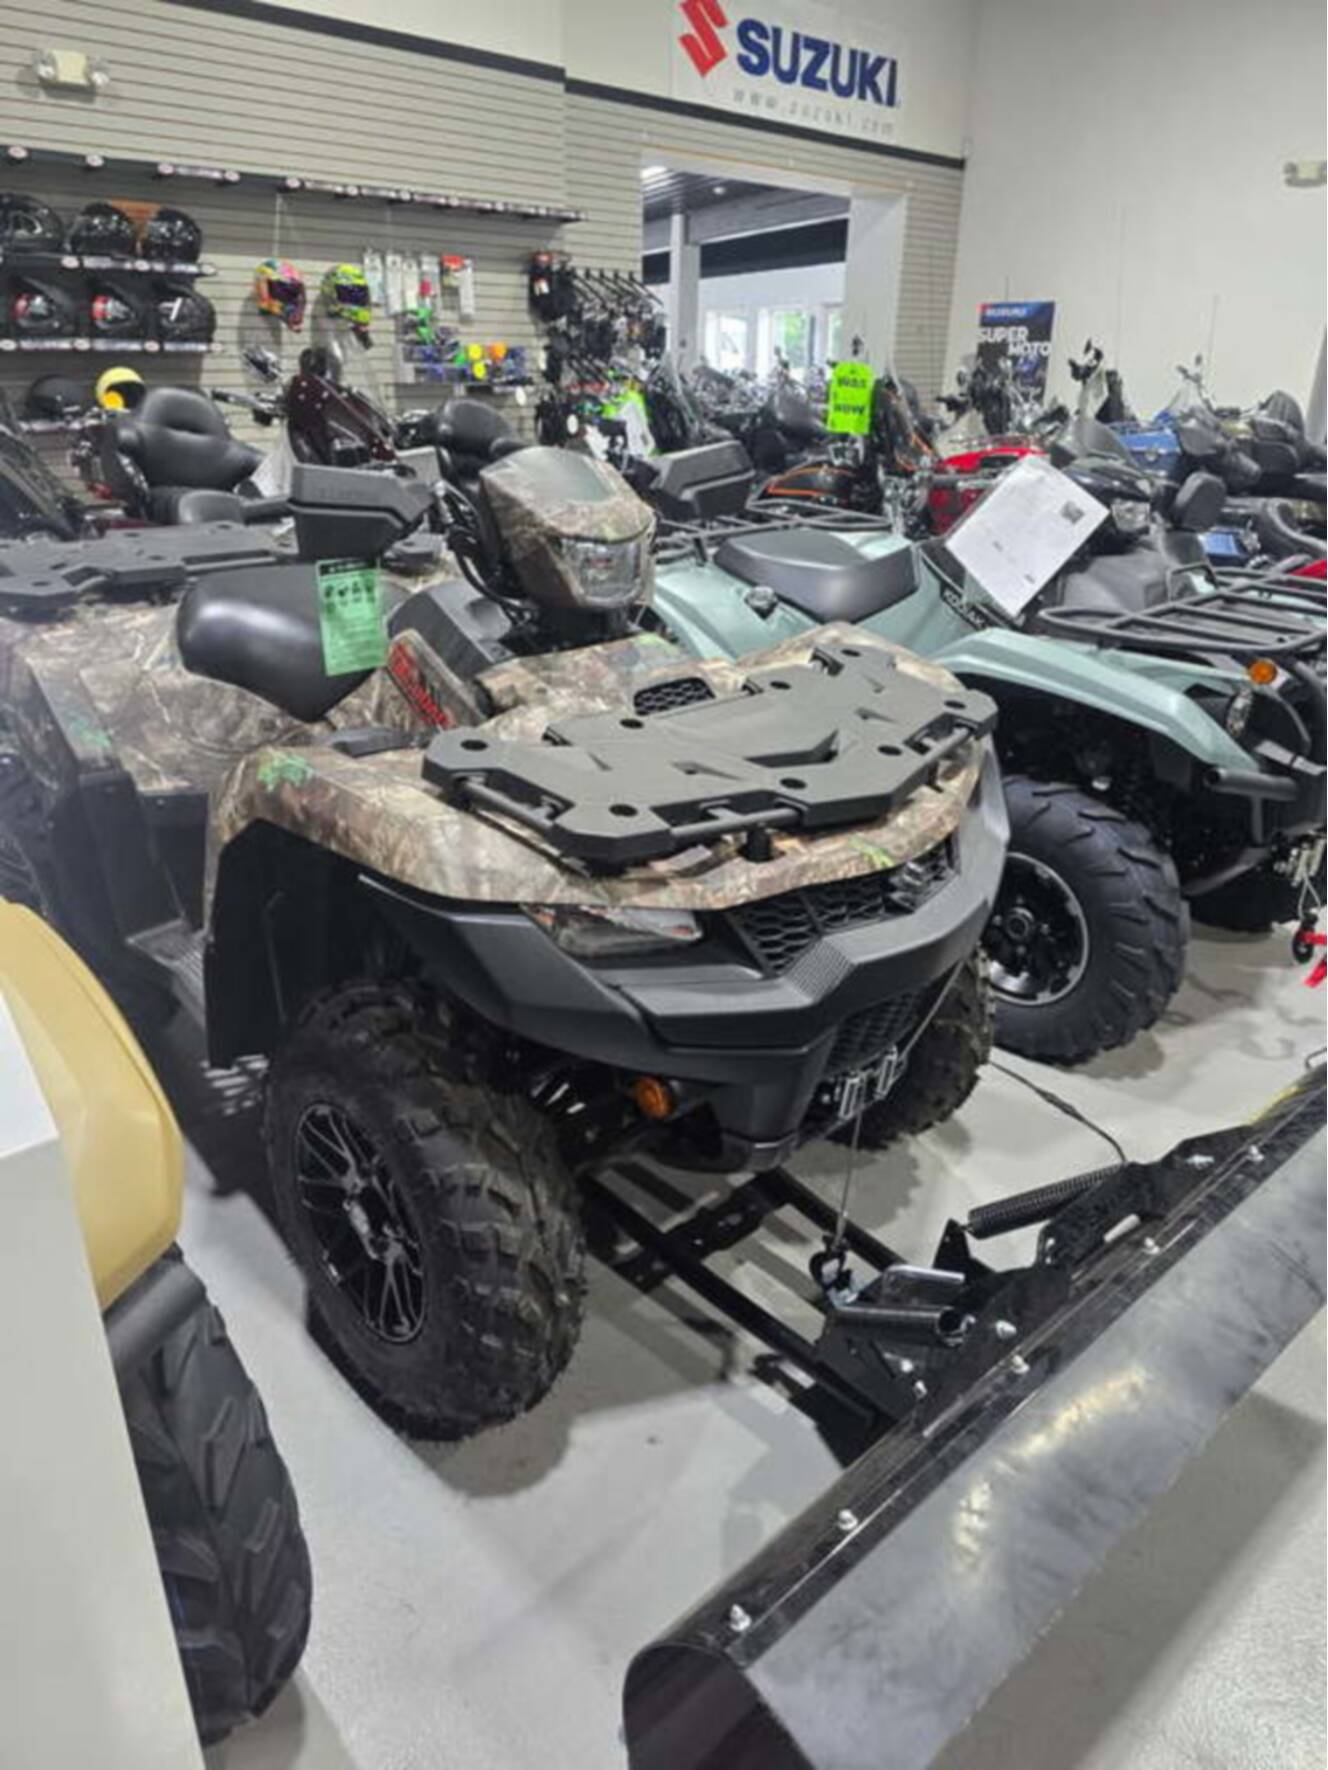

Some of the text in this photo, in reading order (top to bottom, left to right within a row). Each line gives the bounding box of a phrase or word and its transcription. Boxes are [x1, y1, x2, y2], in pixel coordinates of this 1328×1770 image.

[736, 18, 898, 108] SUZUKI
[978, 326, 1029, 343] SUPER
[1008, 341, 1052, 357] MOTO
